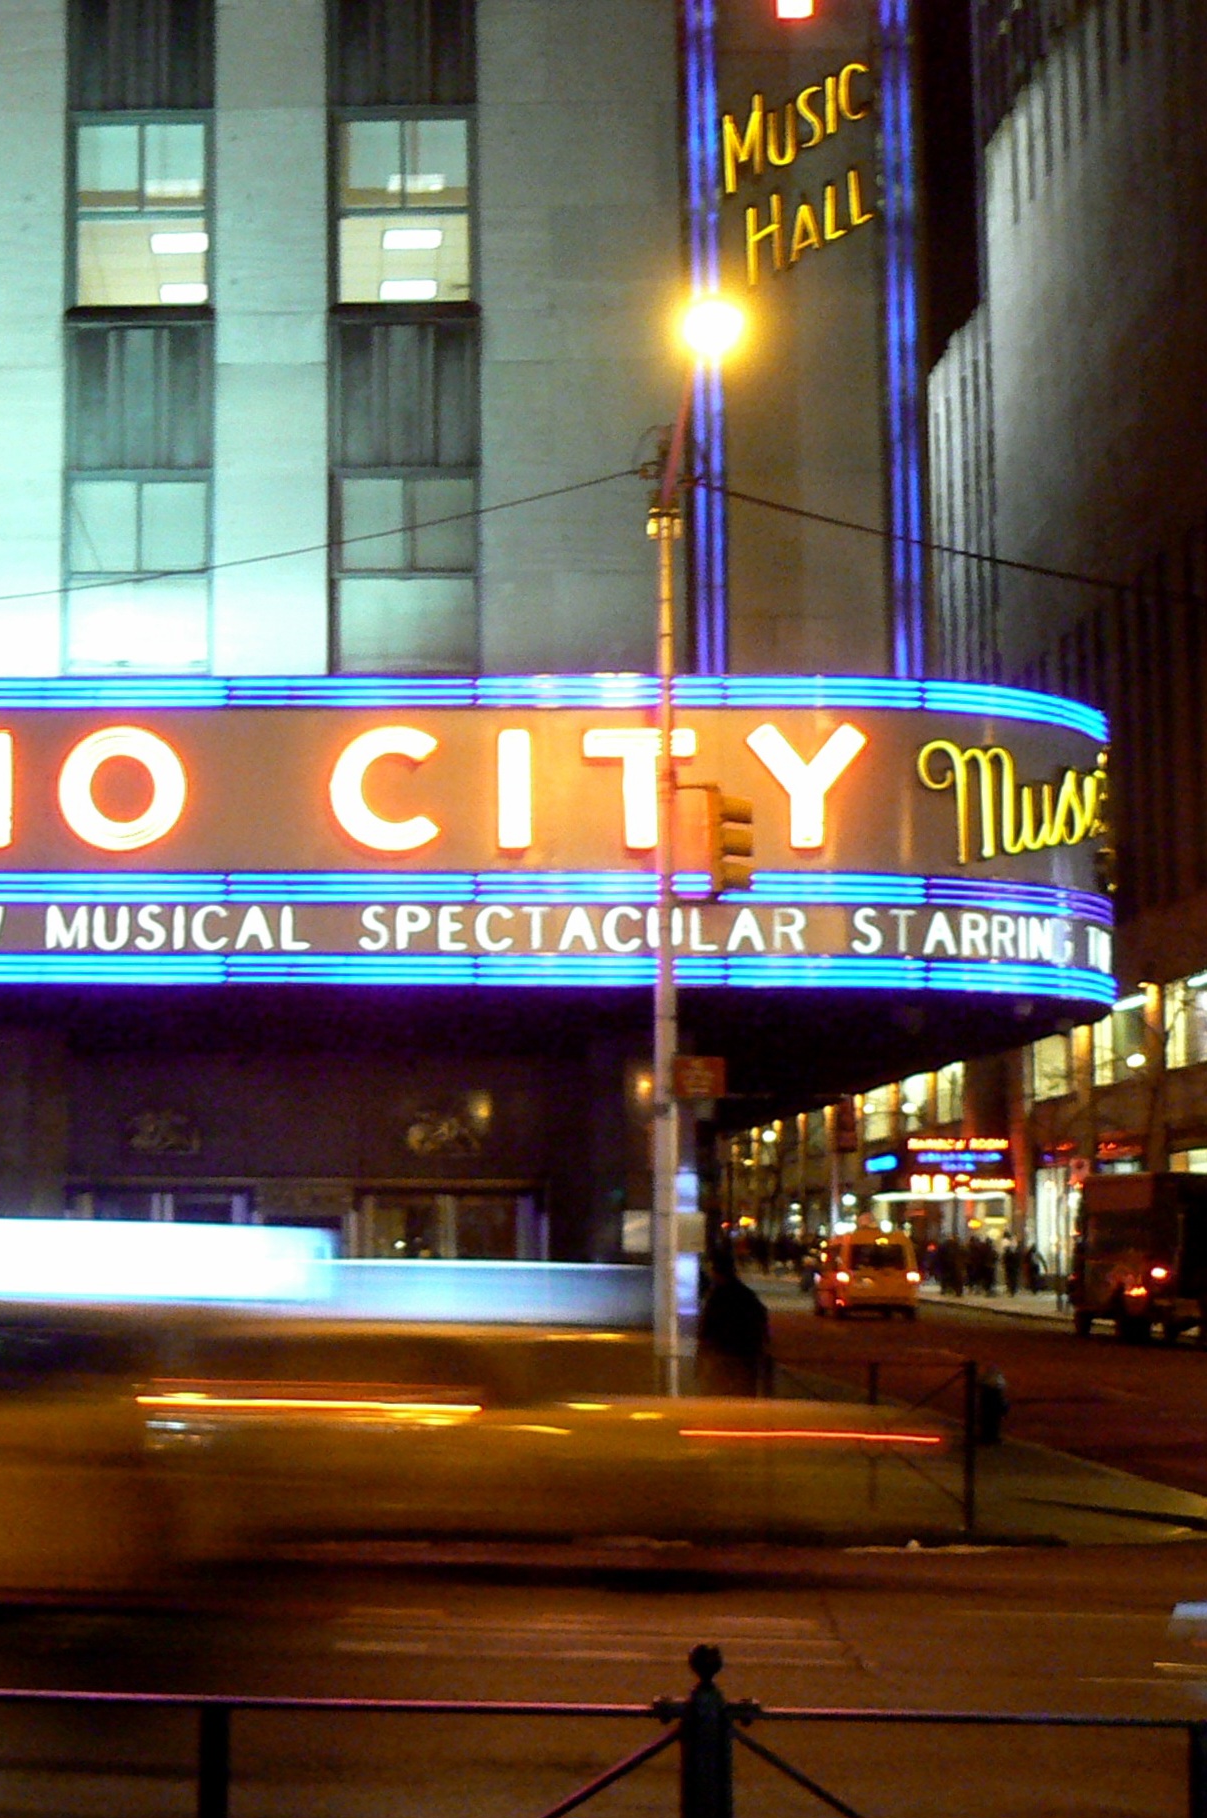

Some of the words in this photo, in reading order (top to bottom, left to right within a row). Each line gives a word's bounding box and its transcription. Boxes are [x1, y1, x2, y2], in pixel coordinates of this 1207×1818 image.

[722, 62, 870, 194] MUSIC
[746, 170, 875, 286] HALL
[329, 722, 868, 852] CITY
[44, 905, 311, 951] MUSICAL
[359, 905, 807, 952] SPECTACULAR
[851, 907, 1075, 963] STARRING
